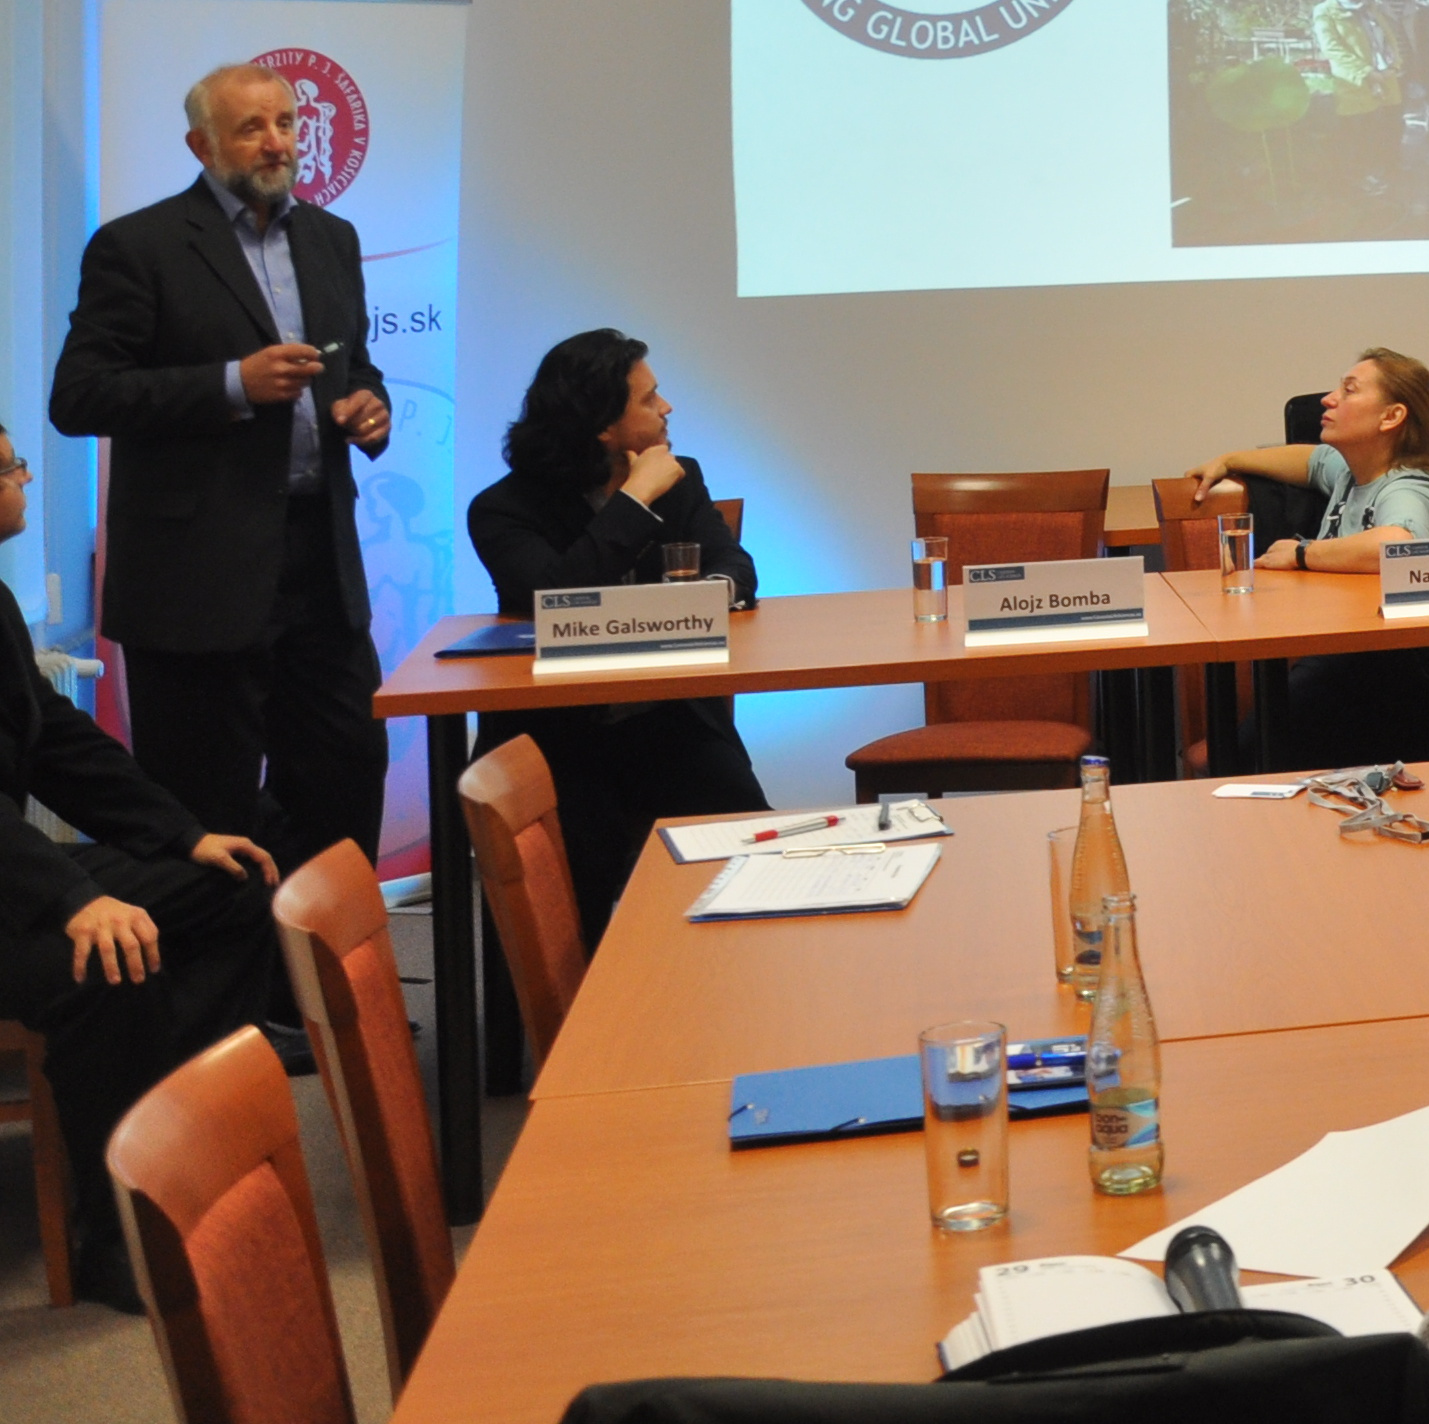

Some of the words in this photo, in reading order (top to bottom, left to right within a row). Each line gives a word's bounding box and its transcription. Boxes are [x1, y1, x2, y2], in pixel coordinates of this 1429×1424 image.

[866, 10, 999, 50] GLOBAL
[370, 303, 442, 342] js.sk
[1000, 595, 1043, 613] Alojz
[1049, 591, 1111, 609] Bomba
[552, 621, 600, 638] Mike
[606, 615, 714, 636] Galsworthy
[1344, 1274, 1376, 1287] 30
